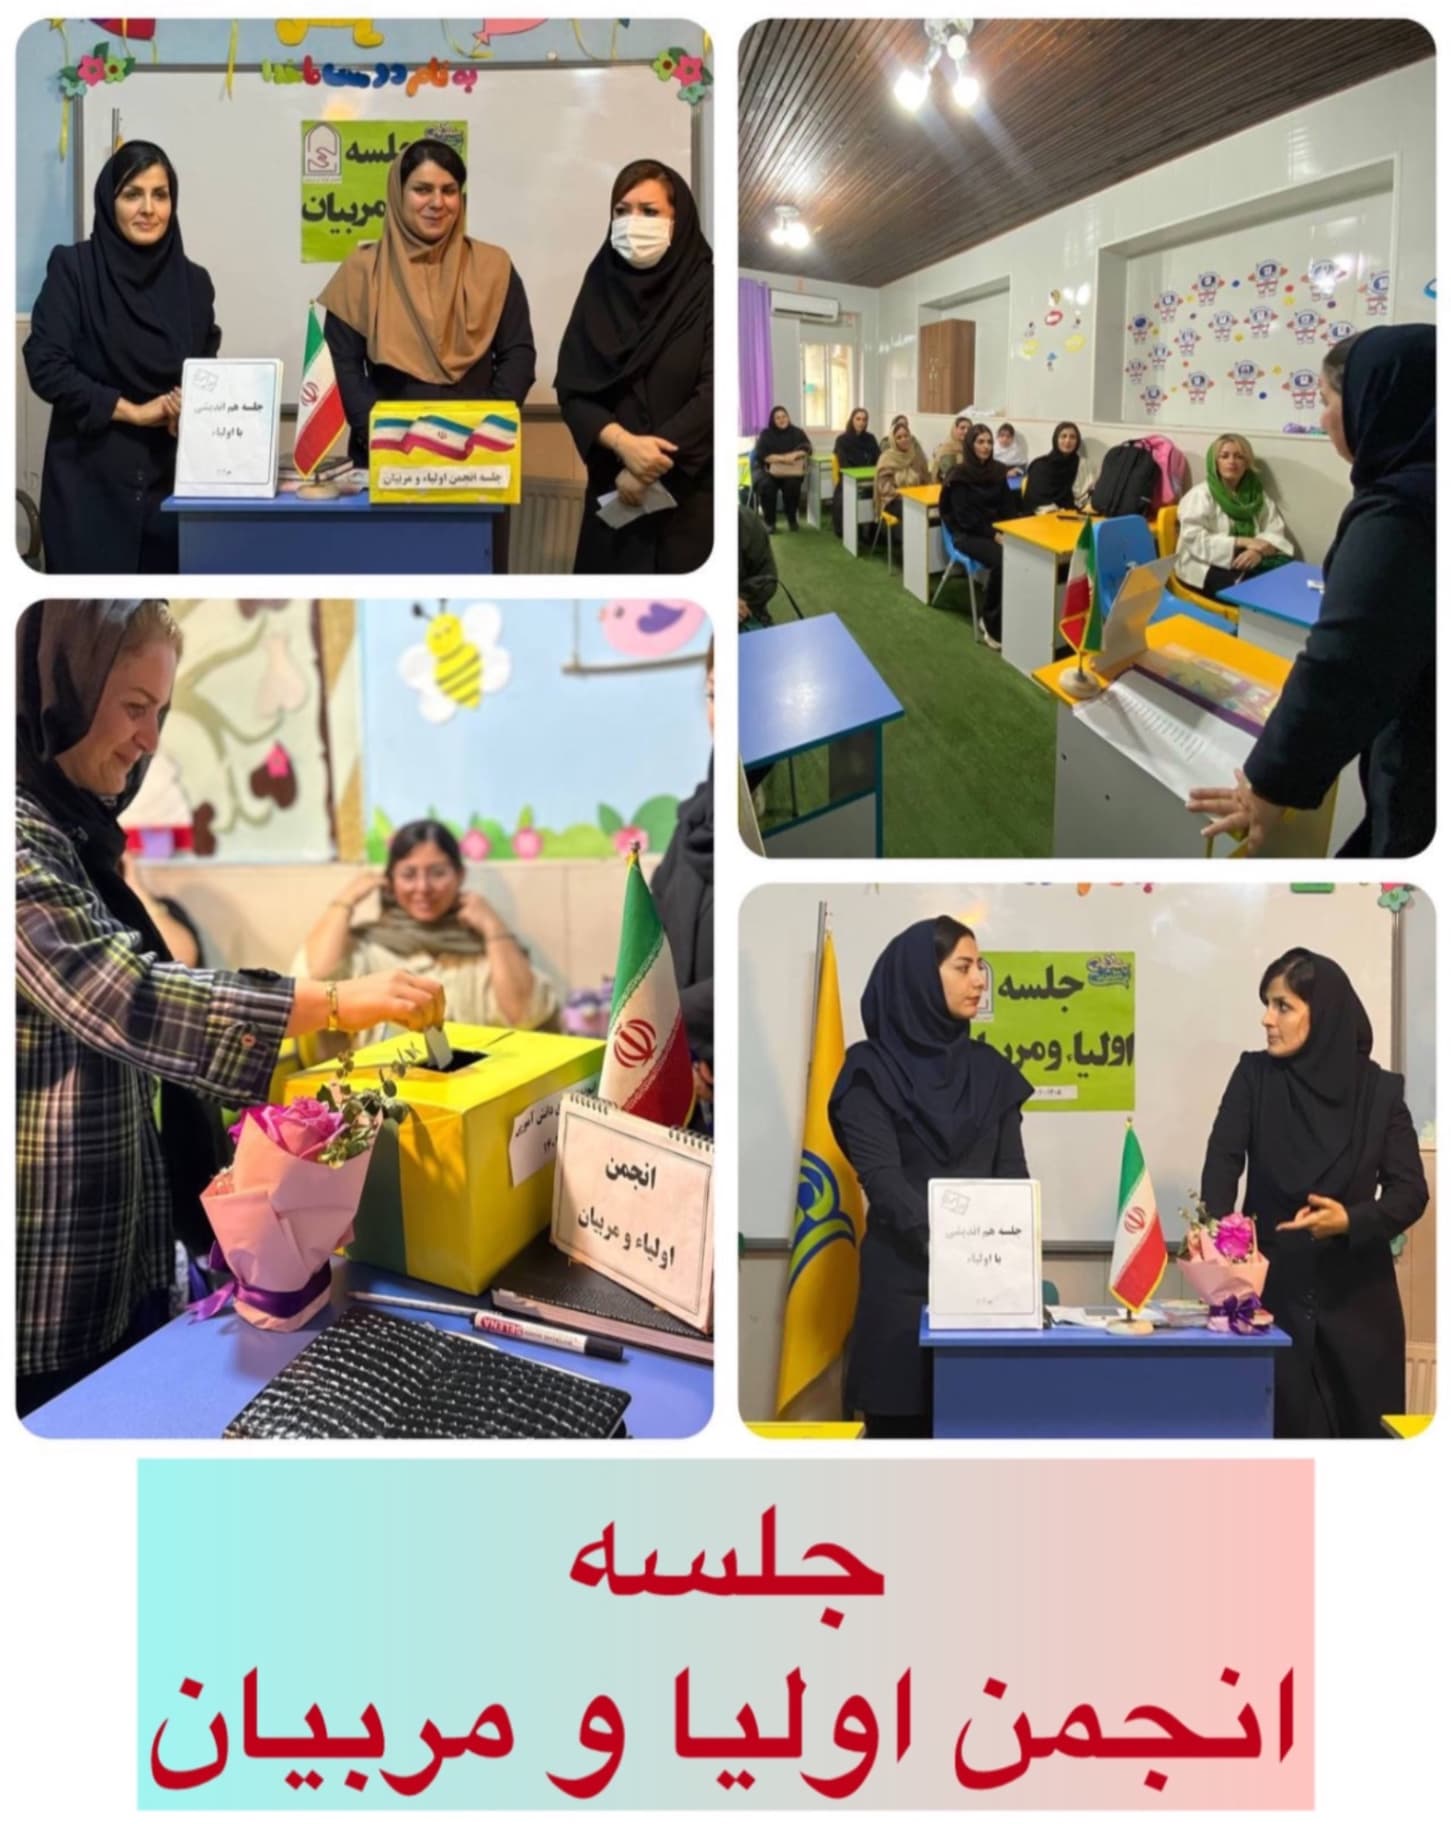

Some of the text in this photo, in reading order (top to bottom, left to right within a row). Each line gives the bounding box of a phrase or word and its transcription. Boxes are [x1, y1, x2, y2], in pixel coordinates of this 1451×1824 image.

[261, 57, 304, 86] خدا
[406, 55, 449, 97] نام
[452, 65, 478, 93] به
[346, 131, 412, 163] لسه
[301, 191, 387, 234] مربیان
[241, 401, 264, 415] جلسه
[383, 473, 413, 486] مربیان
[448, 472, 477, 485] انجمن
[480, 472, 502, 484] جلسه
[997, 964, 1085, 1014] جلسه
[605, 1157, 657, 1190] انجمن
[578, 1206, 676, 1270] اولیاء و مربیان
[998, 1224, 1022, 1238] جلسه
